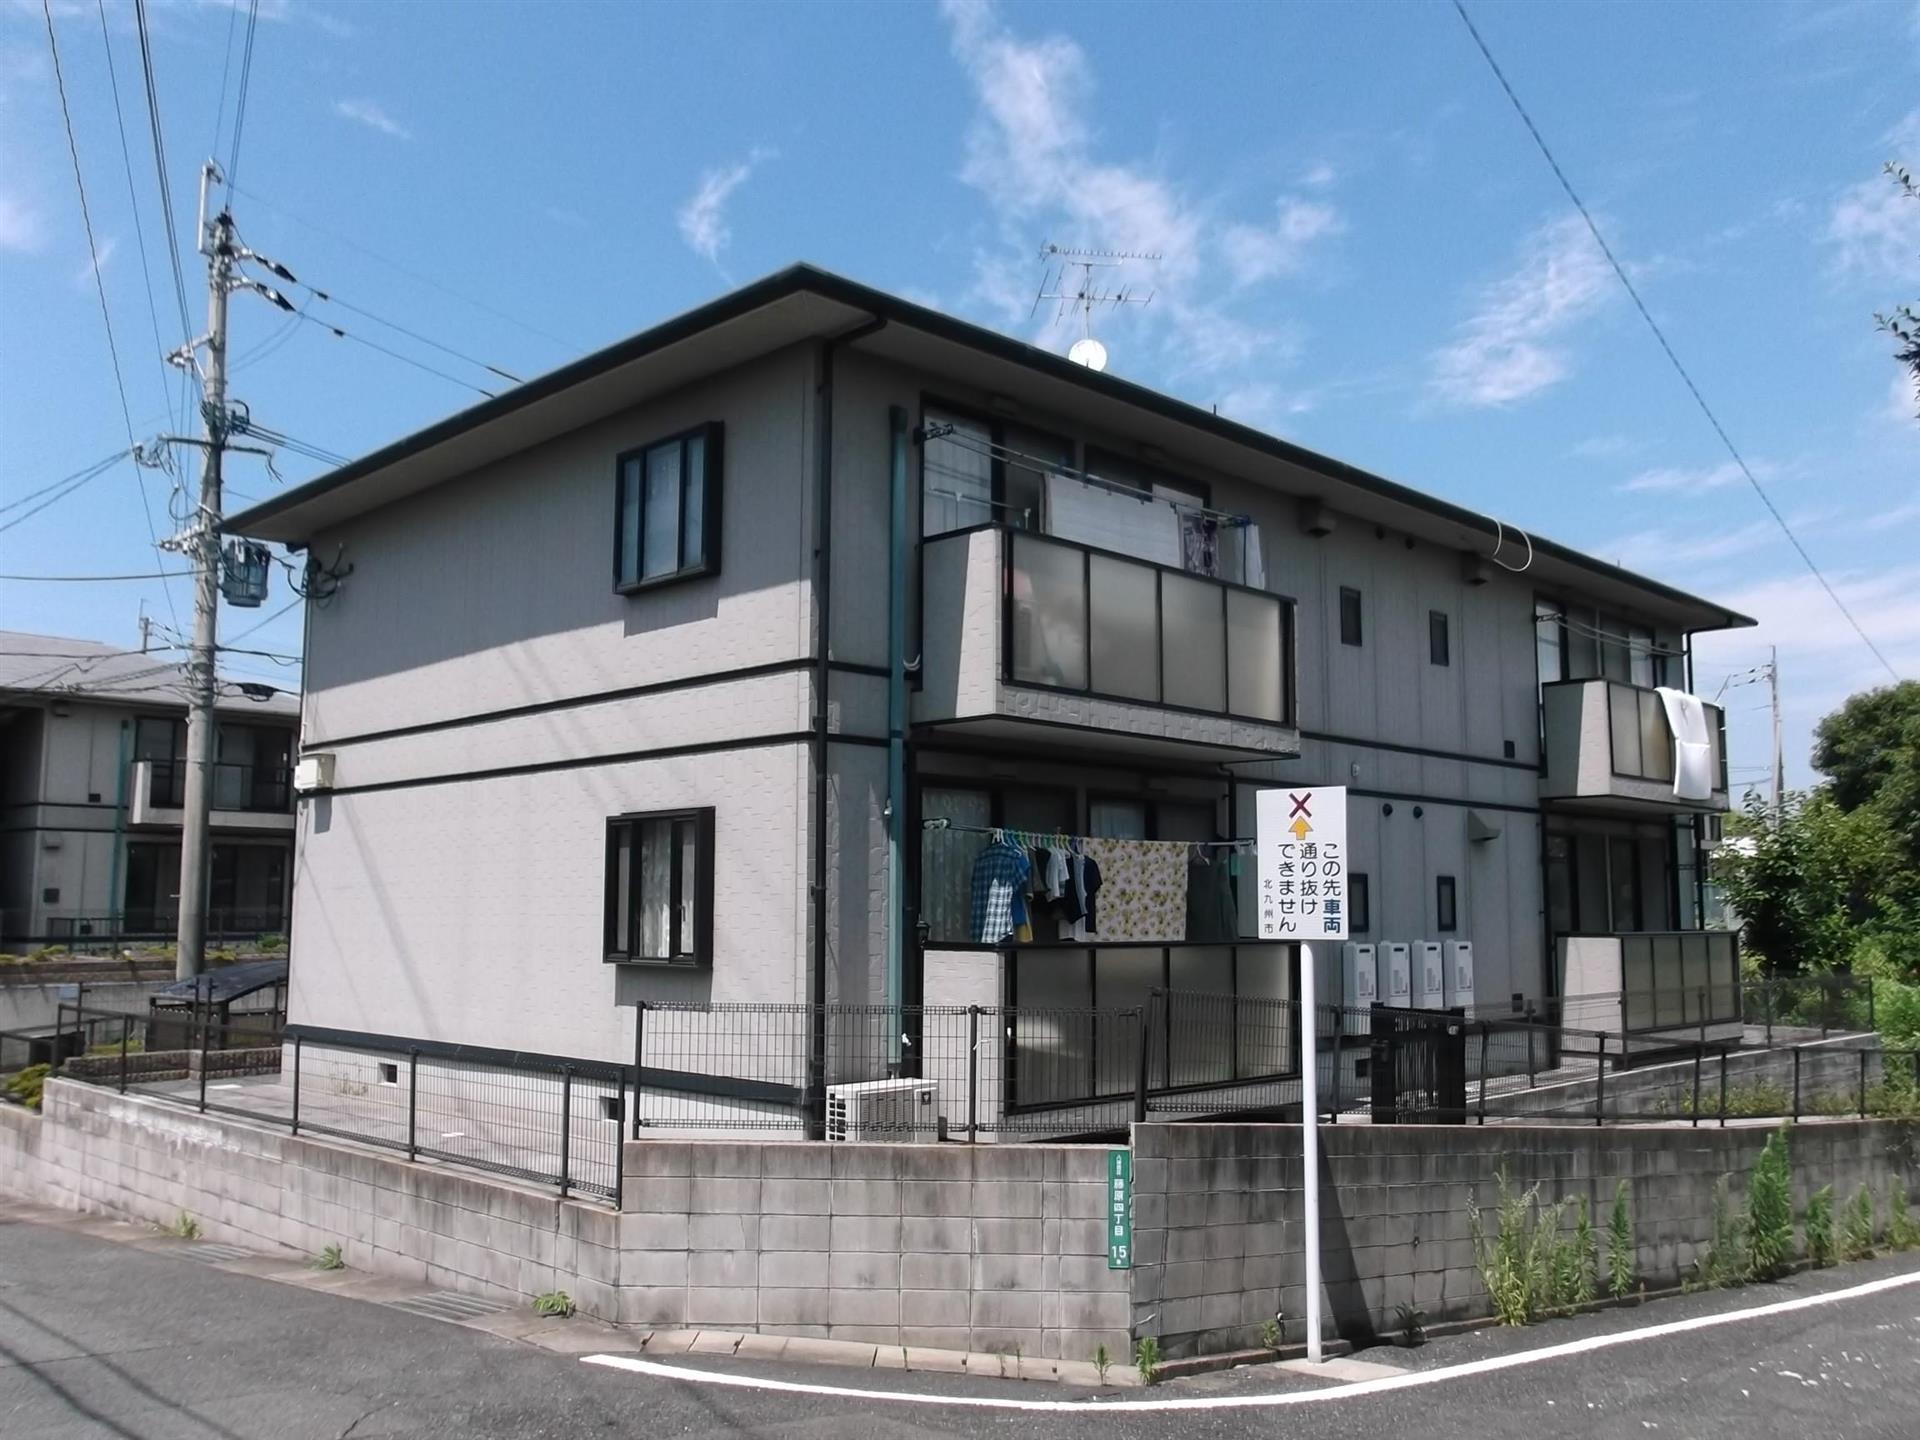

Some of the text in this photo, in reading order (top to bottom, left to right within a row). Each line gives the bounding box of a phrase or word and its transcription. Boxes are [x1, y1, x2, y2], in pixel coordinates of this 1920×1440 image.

[1263, 879, 1273, 934] 北九州市
[1278, 844, 1297, 932] できません
[1300, 842, 1318, 915] 通り抜け
[1322, 843, 1341, 933] この先車両
[1112, 1245, 1127, 1258] 15
